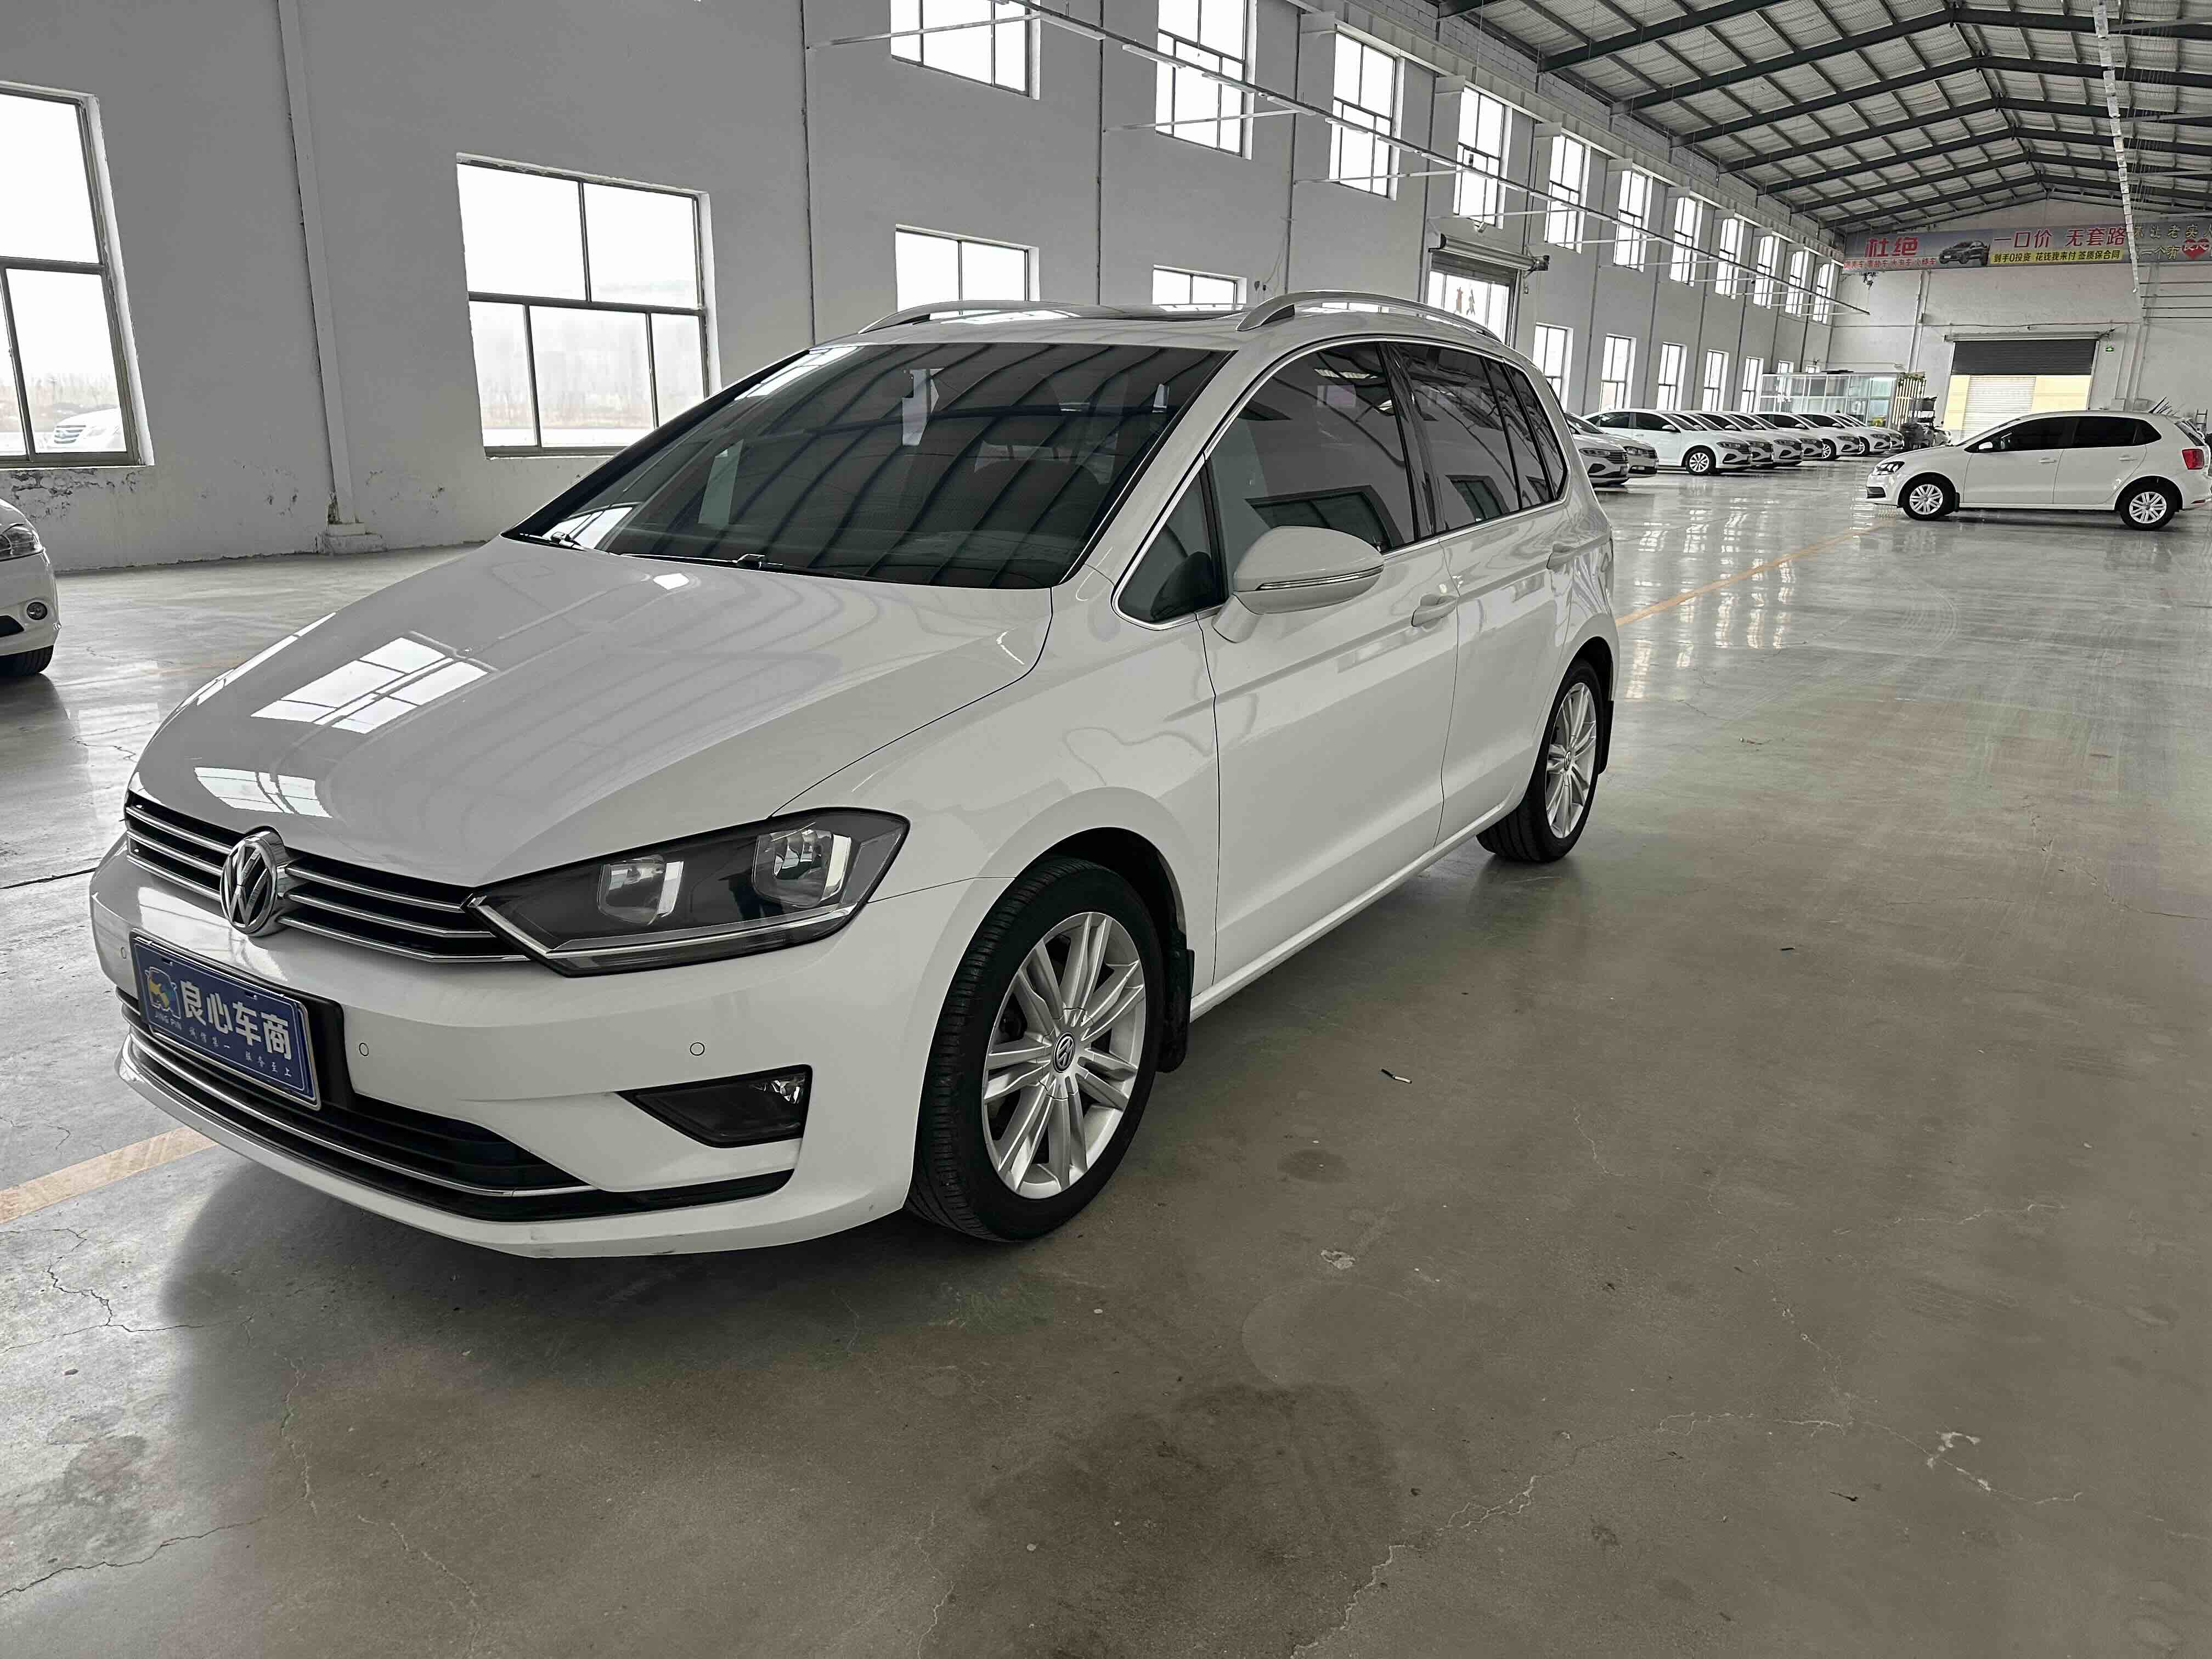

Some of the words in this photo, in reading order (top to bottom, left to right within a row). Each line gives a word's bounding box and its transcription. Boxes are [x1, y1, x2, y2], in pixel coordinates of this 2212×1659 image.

[1865, 236, 1918, 257] 杜绝
[1993, 228, 2053, 248] 一口价
[2064, 227, 2126, 246] 无套路
[2137, 245, 2181, 260] 一个有
[180, 981, 292, 1060] 良心车商
